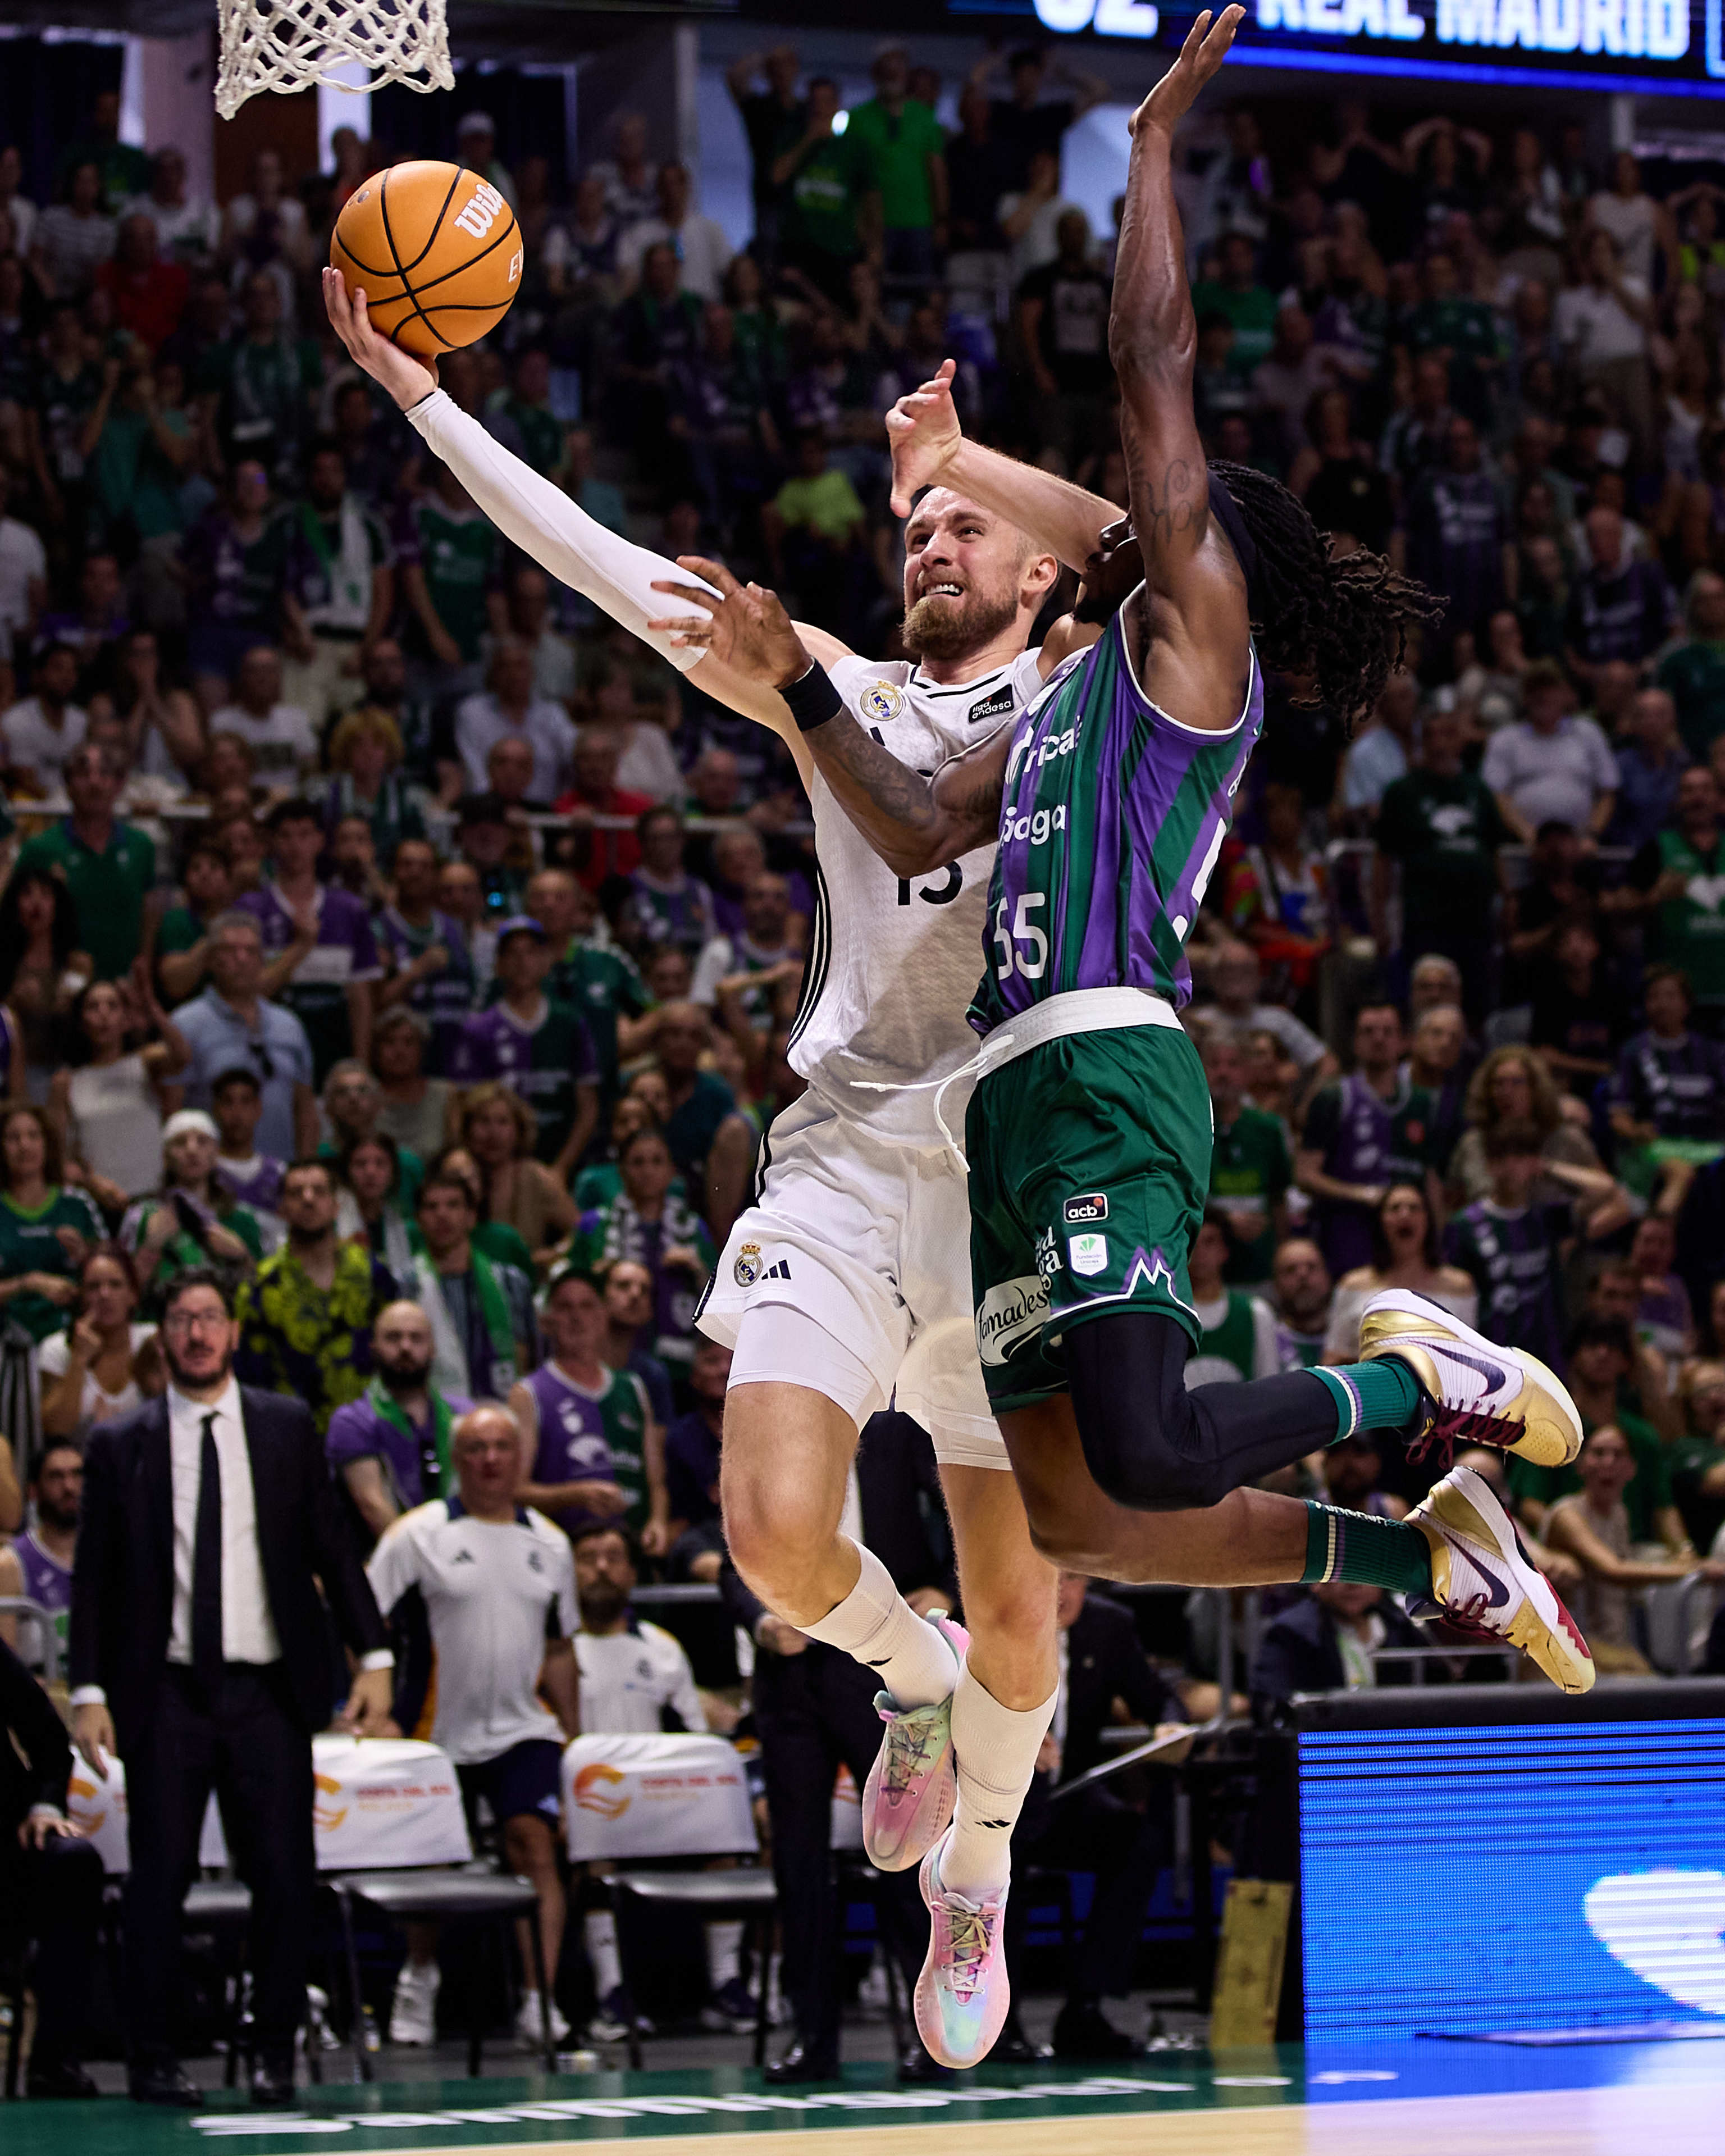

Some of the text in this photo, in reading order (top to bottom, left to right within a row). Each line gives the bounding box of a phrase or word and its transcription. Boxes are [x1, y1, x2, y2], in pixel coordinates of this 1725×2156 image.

[1435, 0, 1690, 60] MADRID
[972, 701, 1012, 719] endesa
[973, 701, 990, 713] liga
[1068, 1204, 1098, 1219] acb
[979, 1286, 1048, 1347] famades
